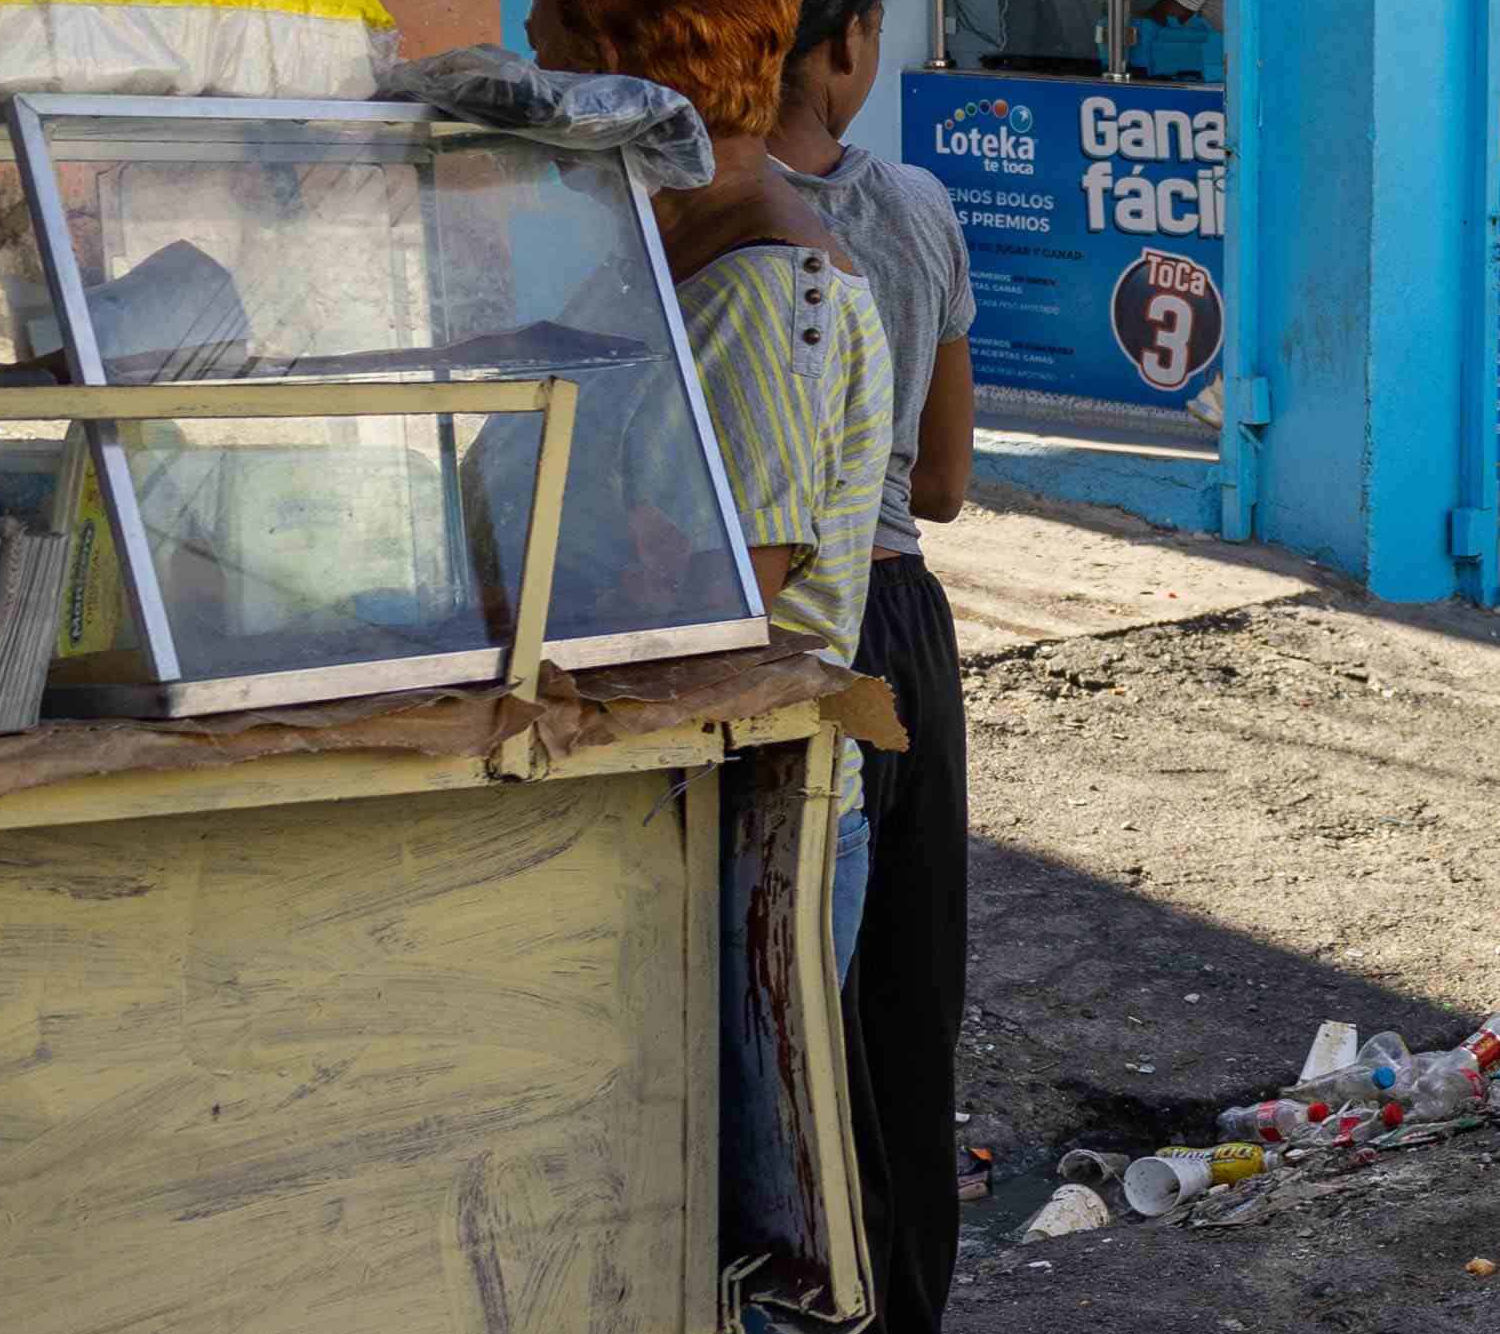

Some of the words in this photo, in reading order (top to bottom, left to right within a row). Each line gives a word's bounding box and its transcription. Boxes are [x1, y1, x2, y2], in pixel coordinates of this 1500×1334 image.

[936, 123, 1035, 161] Loteka
[1080, 96, 1226, 162] Gana
[983, 158, 999, 173] te
[1001, 159, 1034, 175] toca
[948, 187, 992, 205] ENOS
[996, 191, 1055, 210] BOLOS
[972, 211, 1050, 233] PREMIOS
[1142, 293, 1193, 387] 3
